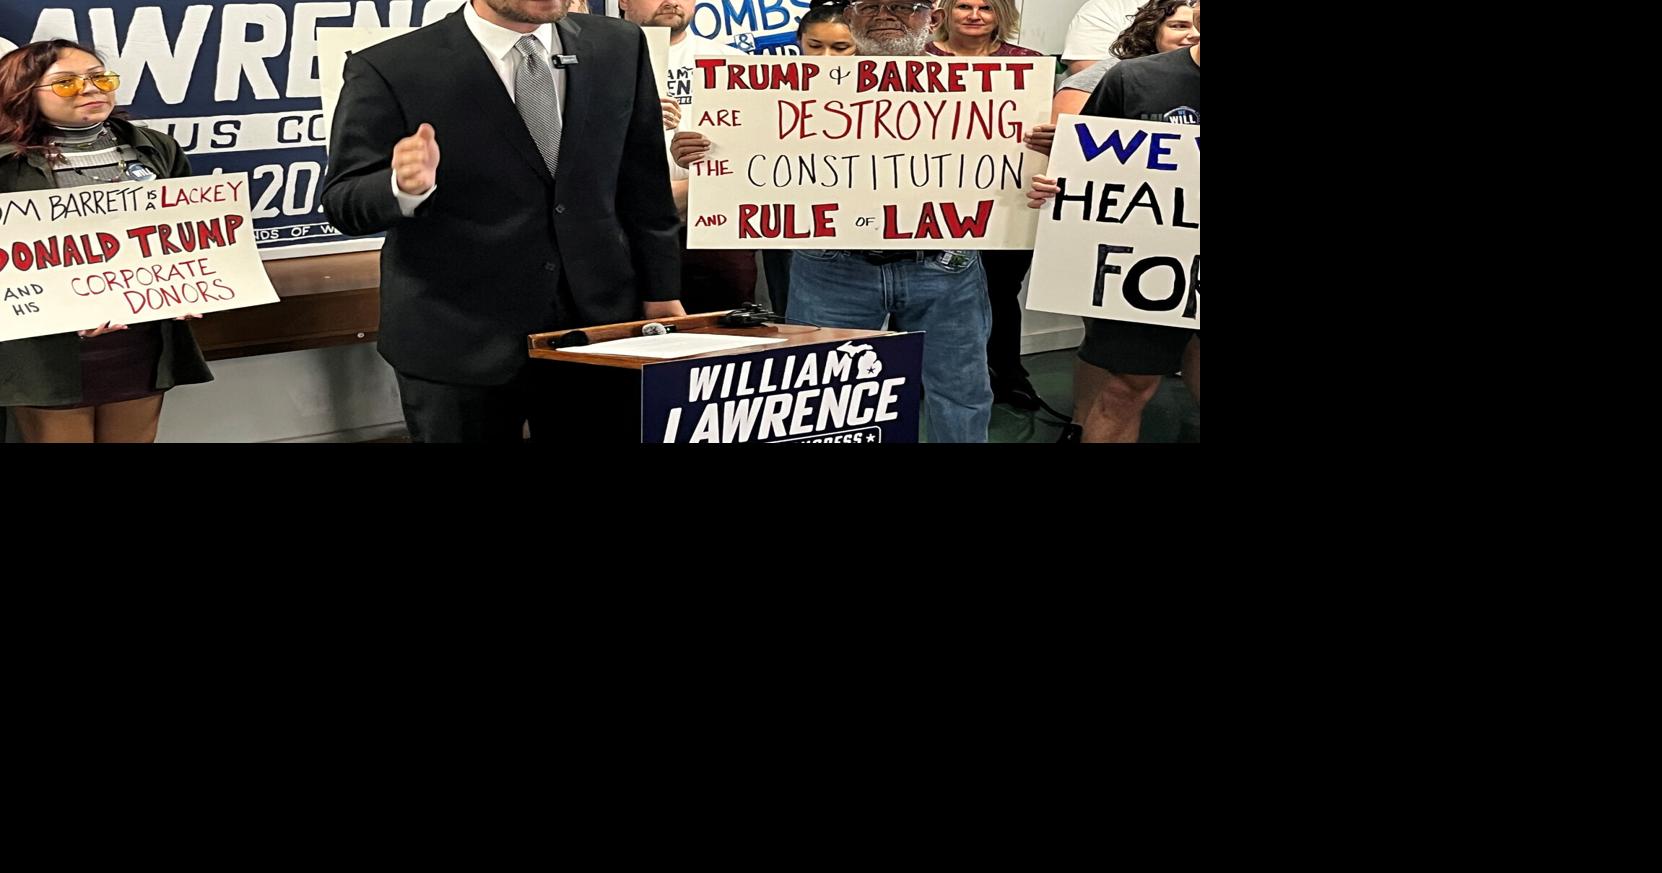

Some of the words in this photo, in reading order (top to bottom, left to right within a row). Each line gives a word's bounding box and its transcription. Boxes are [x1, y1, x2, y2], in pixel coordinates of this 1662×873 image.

[695, 59, 820, 91] TRUMP
[856, 60, 1034, 93] BARRETT
[698, 109, 742, 127] ARE
[777, 99, 1023, 143] DESTROYING
[1074, 122, 1182, 171] WE
[693, 159, 733, 177] THE
[747, 152, 1024, 190] CONSTITUTION
[49, 186, 144, 221] BARRETT
[147, 189, 157, 200] IS
[161, 180, 243, 208] LACKEY
[694, 214, 727, 228] AND
[738, 203, 839, 239] RULE
[856, 216, 876, 228] OF
[883, 200, 995, 240] LAW
[126, 214, 245, 258] TRUMP
[291, 225, 312, 237] OF
[4, 283, 44, 302] AND
[71, 258, 216, 297] CORPORATE
[123, 278, 236, 315] DONORS
[12, 302, 40, 316] HIS
[688, 350, 854, 403] WILLIAM
[662, 377, 907, 443] LAWRENCE
